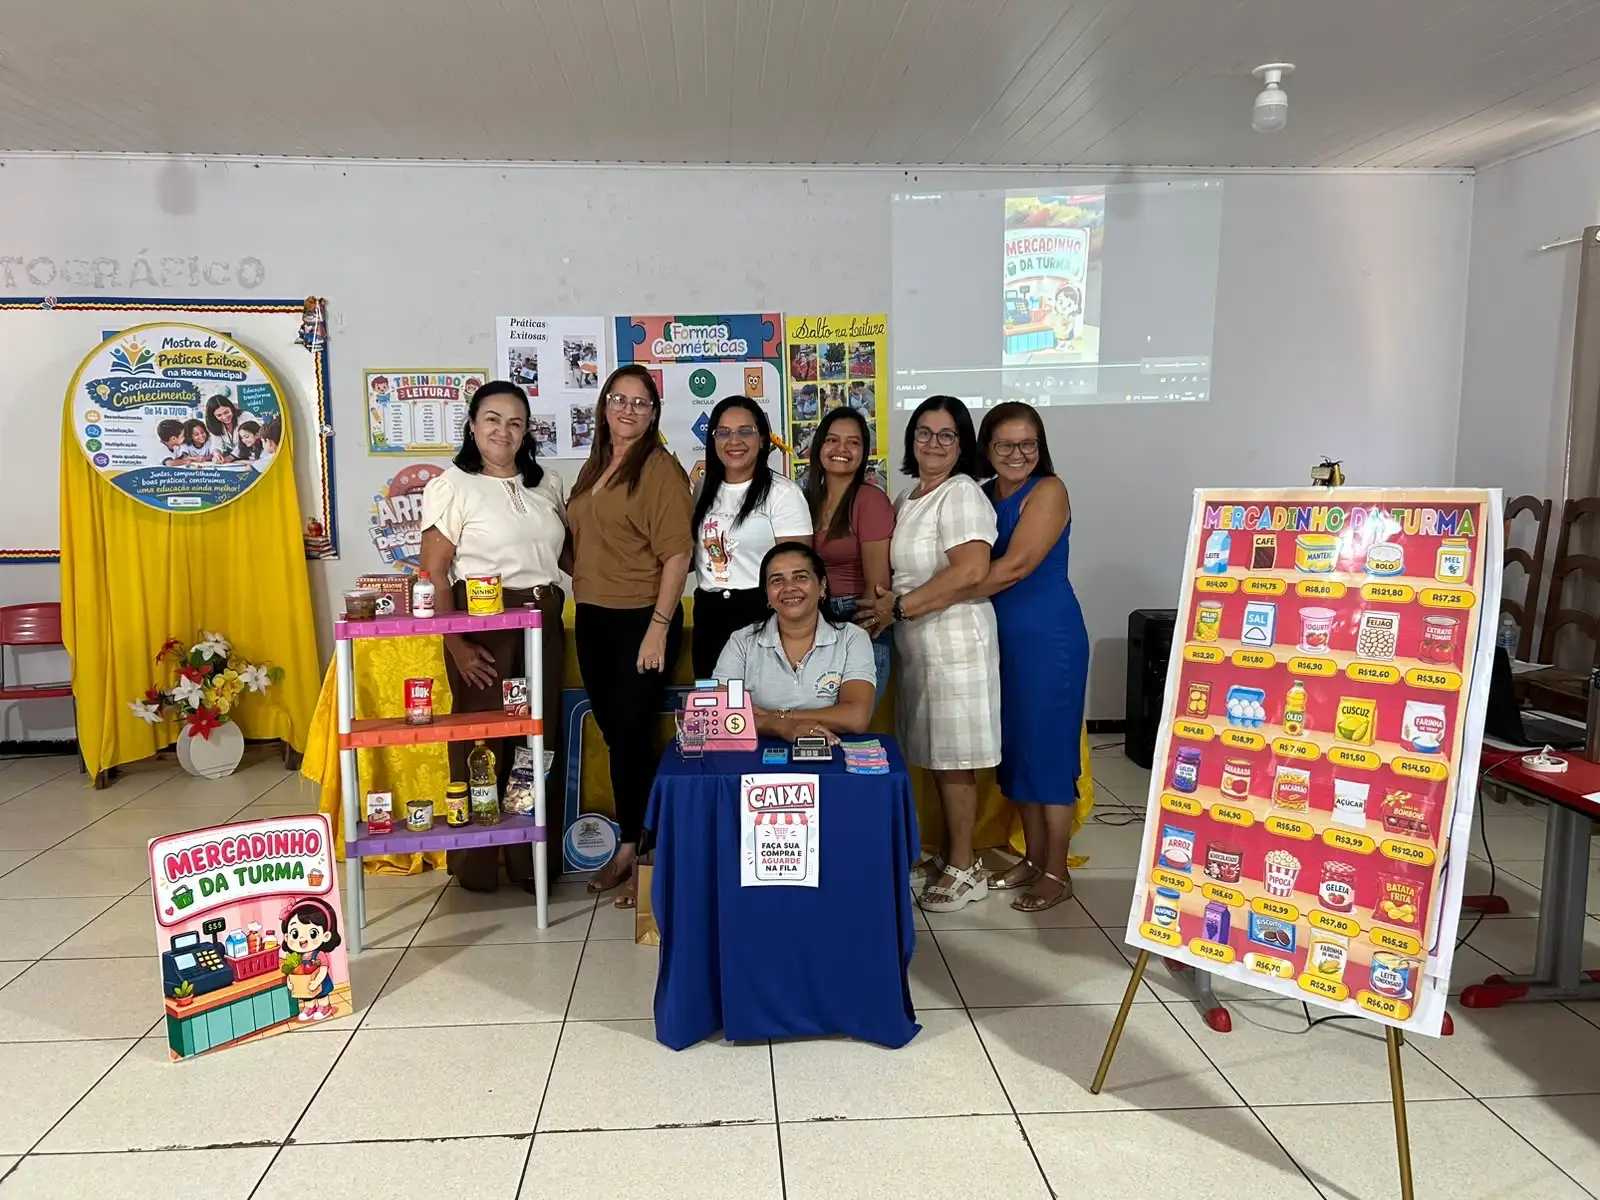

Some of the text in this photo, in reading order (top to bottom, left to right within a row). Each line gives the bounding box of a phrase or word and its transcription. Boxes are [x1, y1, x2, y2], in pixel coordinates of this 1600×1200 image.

[1005, 237, 1081, 256] MERCADINHO
[1020, 257, 1034, 271] DA
[509, 318, 546, 329] Práticas
[792, 317, 885, 339] Salto na Leitura
[509, 330, 547, 341] Exitosas
[672, 325, 726, 339] Formas
[161, 336, 218, 349] Mostra de
[653, 339, 746, 355] Geométricas
[158, 353, 247, 369] Práticas Exitosas
[180, 369, 203, 377] Rede
[203, 369, 242, 380] Municipal
[120, 379, 181, 393] Socializando
[393, 375, 461, 387] TREINANDO
[113, 389, 196, 407] Conhecimentos
[406, 387, 451, 398] LEITURA
[144, 407, 154, 415] De
[154, 407, 162, 415] 14
[1203, 505, 1346, 532] MERCADINHO
[1391, 507, 1476, 537] TURMA
[1444, 556, 1461, 564] MEL
[1205, 580, 1228, 589] R$4,00
[1251, 582, 1277, 591] R$14,75
[1371, 587, 1404, 598] R$21,80
[1432, 593, 1462, 604] R$7,25
[1248, 613, 1267, 625] SAL
[1426, 626, 1452, 635] EXTRATO
[1192, 651, 1215, 660] R$2,20
[1241, 655, 1264, 664] R$1,80
[1297, 661, 1323, 671] R$6,90
[1358, 668, 1390, 678] R$12,60
[1416, 674, 1446, 685] R$3,50
[1341, 704, 1370, 719] CUSCUZ
[1415, 717, 1443, 728] FARINHA
[1231, 734, 1254, 744] R$8,99
[1340, 751, 1366, 763] R$1,50
[1401, 762, 1431, 774] R$4,50
[749, 784, 813, 809] CAIXA
[1335, 798, 1364, 808] AÇÚCAR
[1218, 809, 1241, 820] R$6,90
[1393, 807, 1425, 820] BOMBONS
[1276, 821, 1301, 833] R$5,50
[761, 842, 782, 850] FAÇA
[1167, 838, 1191, 851] ARROZ
[1335, 834, 1363, 847] R$3,99
[165, 830, 321, 881] MERCADINHO
[761, 857, 801, 865] AGUARDE
[198, 860, 305, 897] DA TURMA
[1159, 874, 1185, 888] R$13,90
[1268, 873, 1291, 888] PIPOCA
[1211, 888, 1233, 900] R$5,60
[1325, 882, 1350, 896] GELEIA
[1386, 882, 1415, 898] BATATA
[1390, 891, 1412, 905] FRITA
[1263, 902, 1289, 915] R$2,99
[1320, 916, 1348, 930] R$7,80
[1149, 928, 1171, 940] R$9,99
[1382, 935, 1408, 949] R$5,25
[1200, 945, 1224, 957] R$9,20
[1319, 944, 1343, 956] FARINHA
[1256, 960, 1280, 972] R$6,70
[1374, 975, 1402, 988] CONDENSADO
[1380, 970, 1397, 981] LEITE
[1309, 979, 1337, 994] R$2,95
[1366, 997, 1395, 1012] R$6,00
